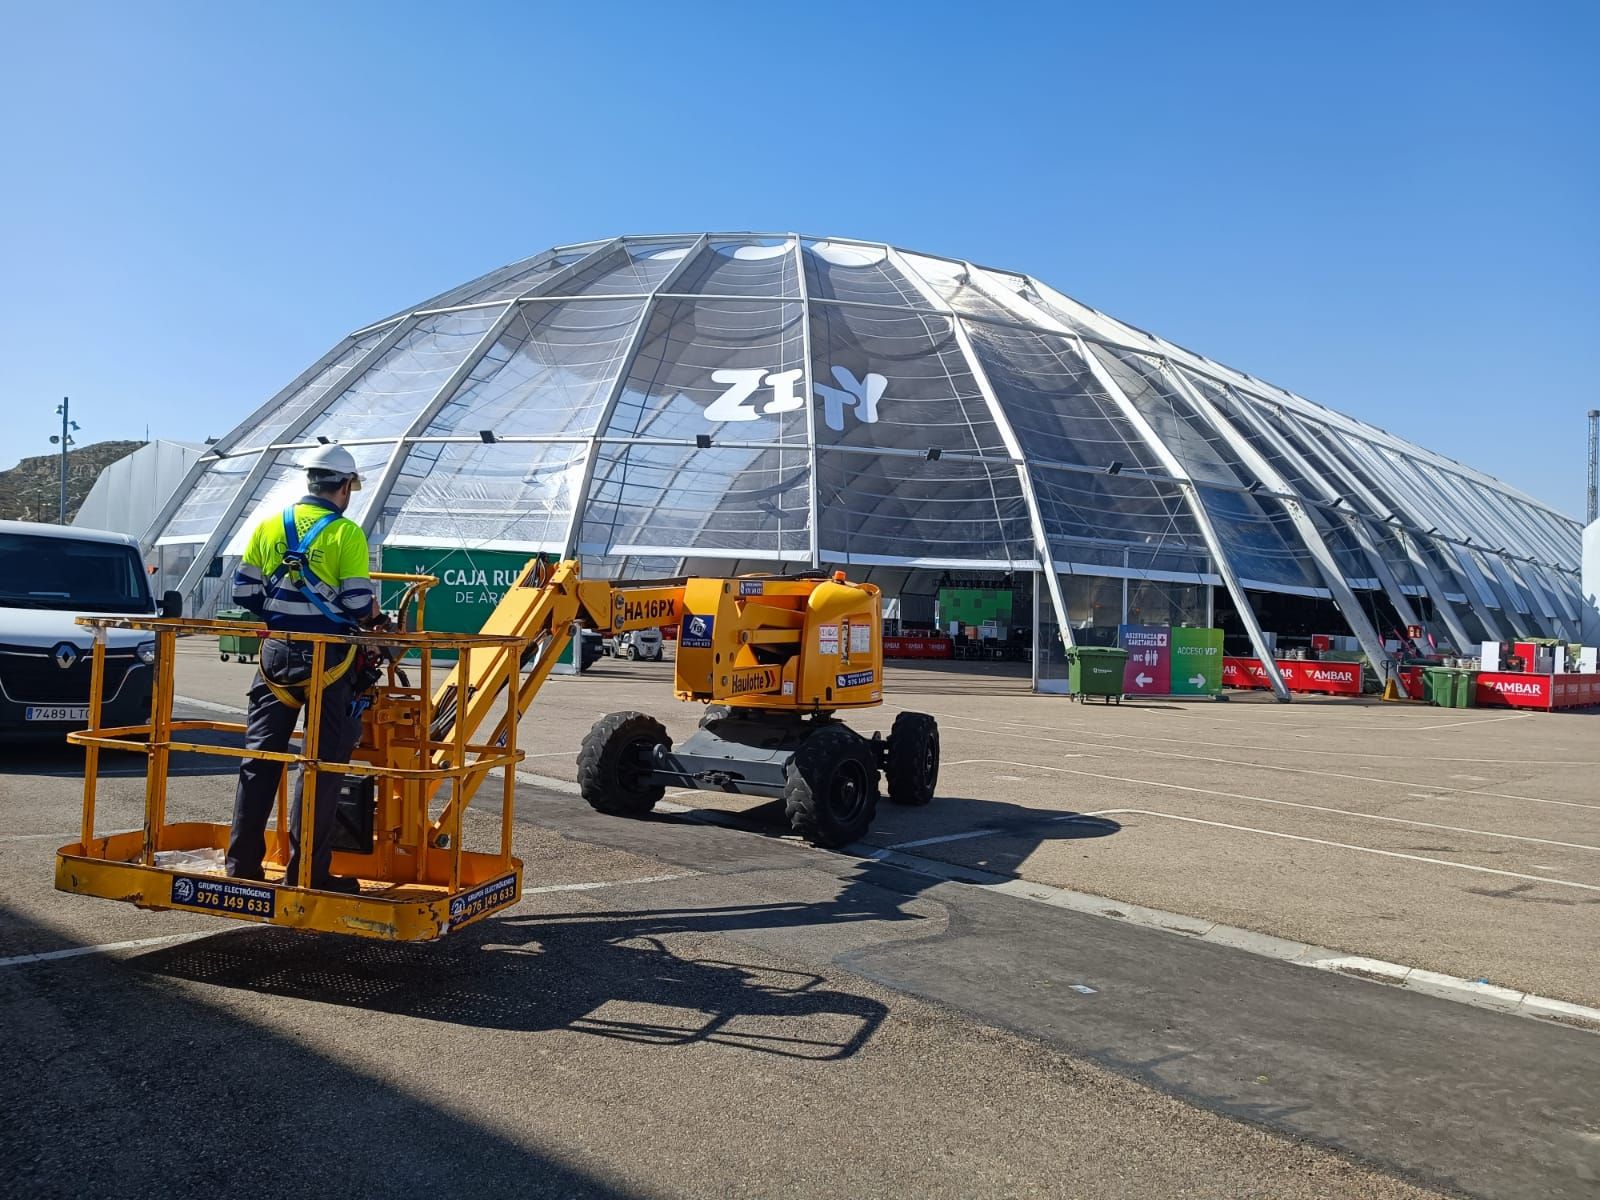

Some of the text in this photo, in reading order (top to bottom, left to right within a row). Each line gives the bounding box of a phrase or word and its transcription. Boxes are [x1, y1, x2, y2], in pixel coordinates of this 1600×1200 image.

[703, 365, 888, 431] ZITY
[443, 569, 522, 586] CAJA RU
[455, 591, 475, 604] DE
[624, 599, 675, 621] HA16PX
[1133, 654, 1143, 662] WC
[1177, 646, 1217, 656] ACCESO VIP
[1313, 670, 1353, 681] AMBAR
[732, 674, 764, 694] Haulotte
[1495, 682, 1542, 695] AMBAR
[35, 708, 66, 719] 7489
[197, 881, 271, 899] GRUPOS ELECTRÓGENOS
[467, 890, 484, 902] GRUPOS
[197, 891, 271, 913] 976 149 633
[467, 886, 514, 916] 976 149 633
